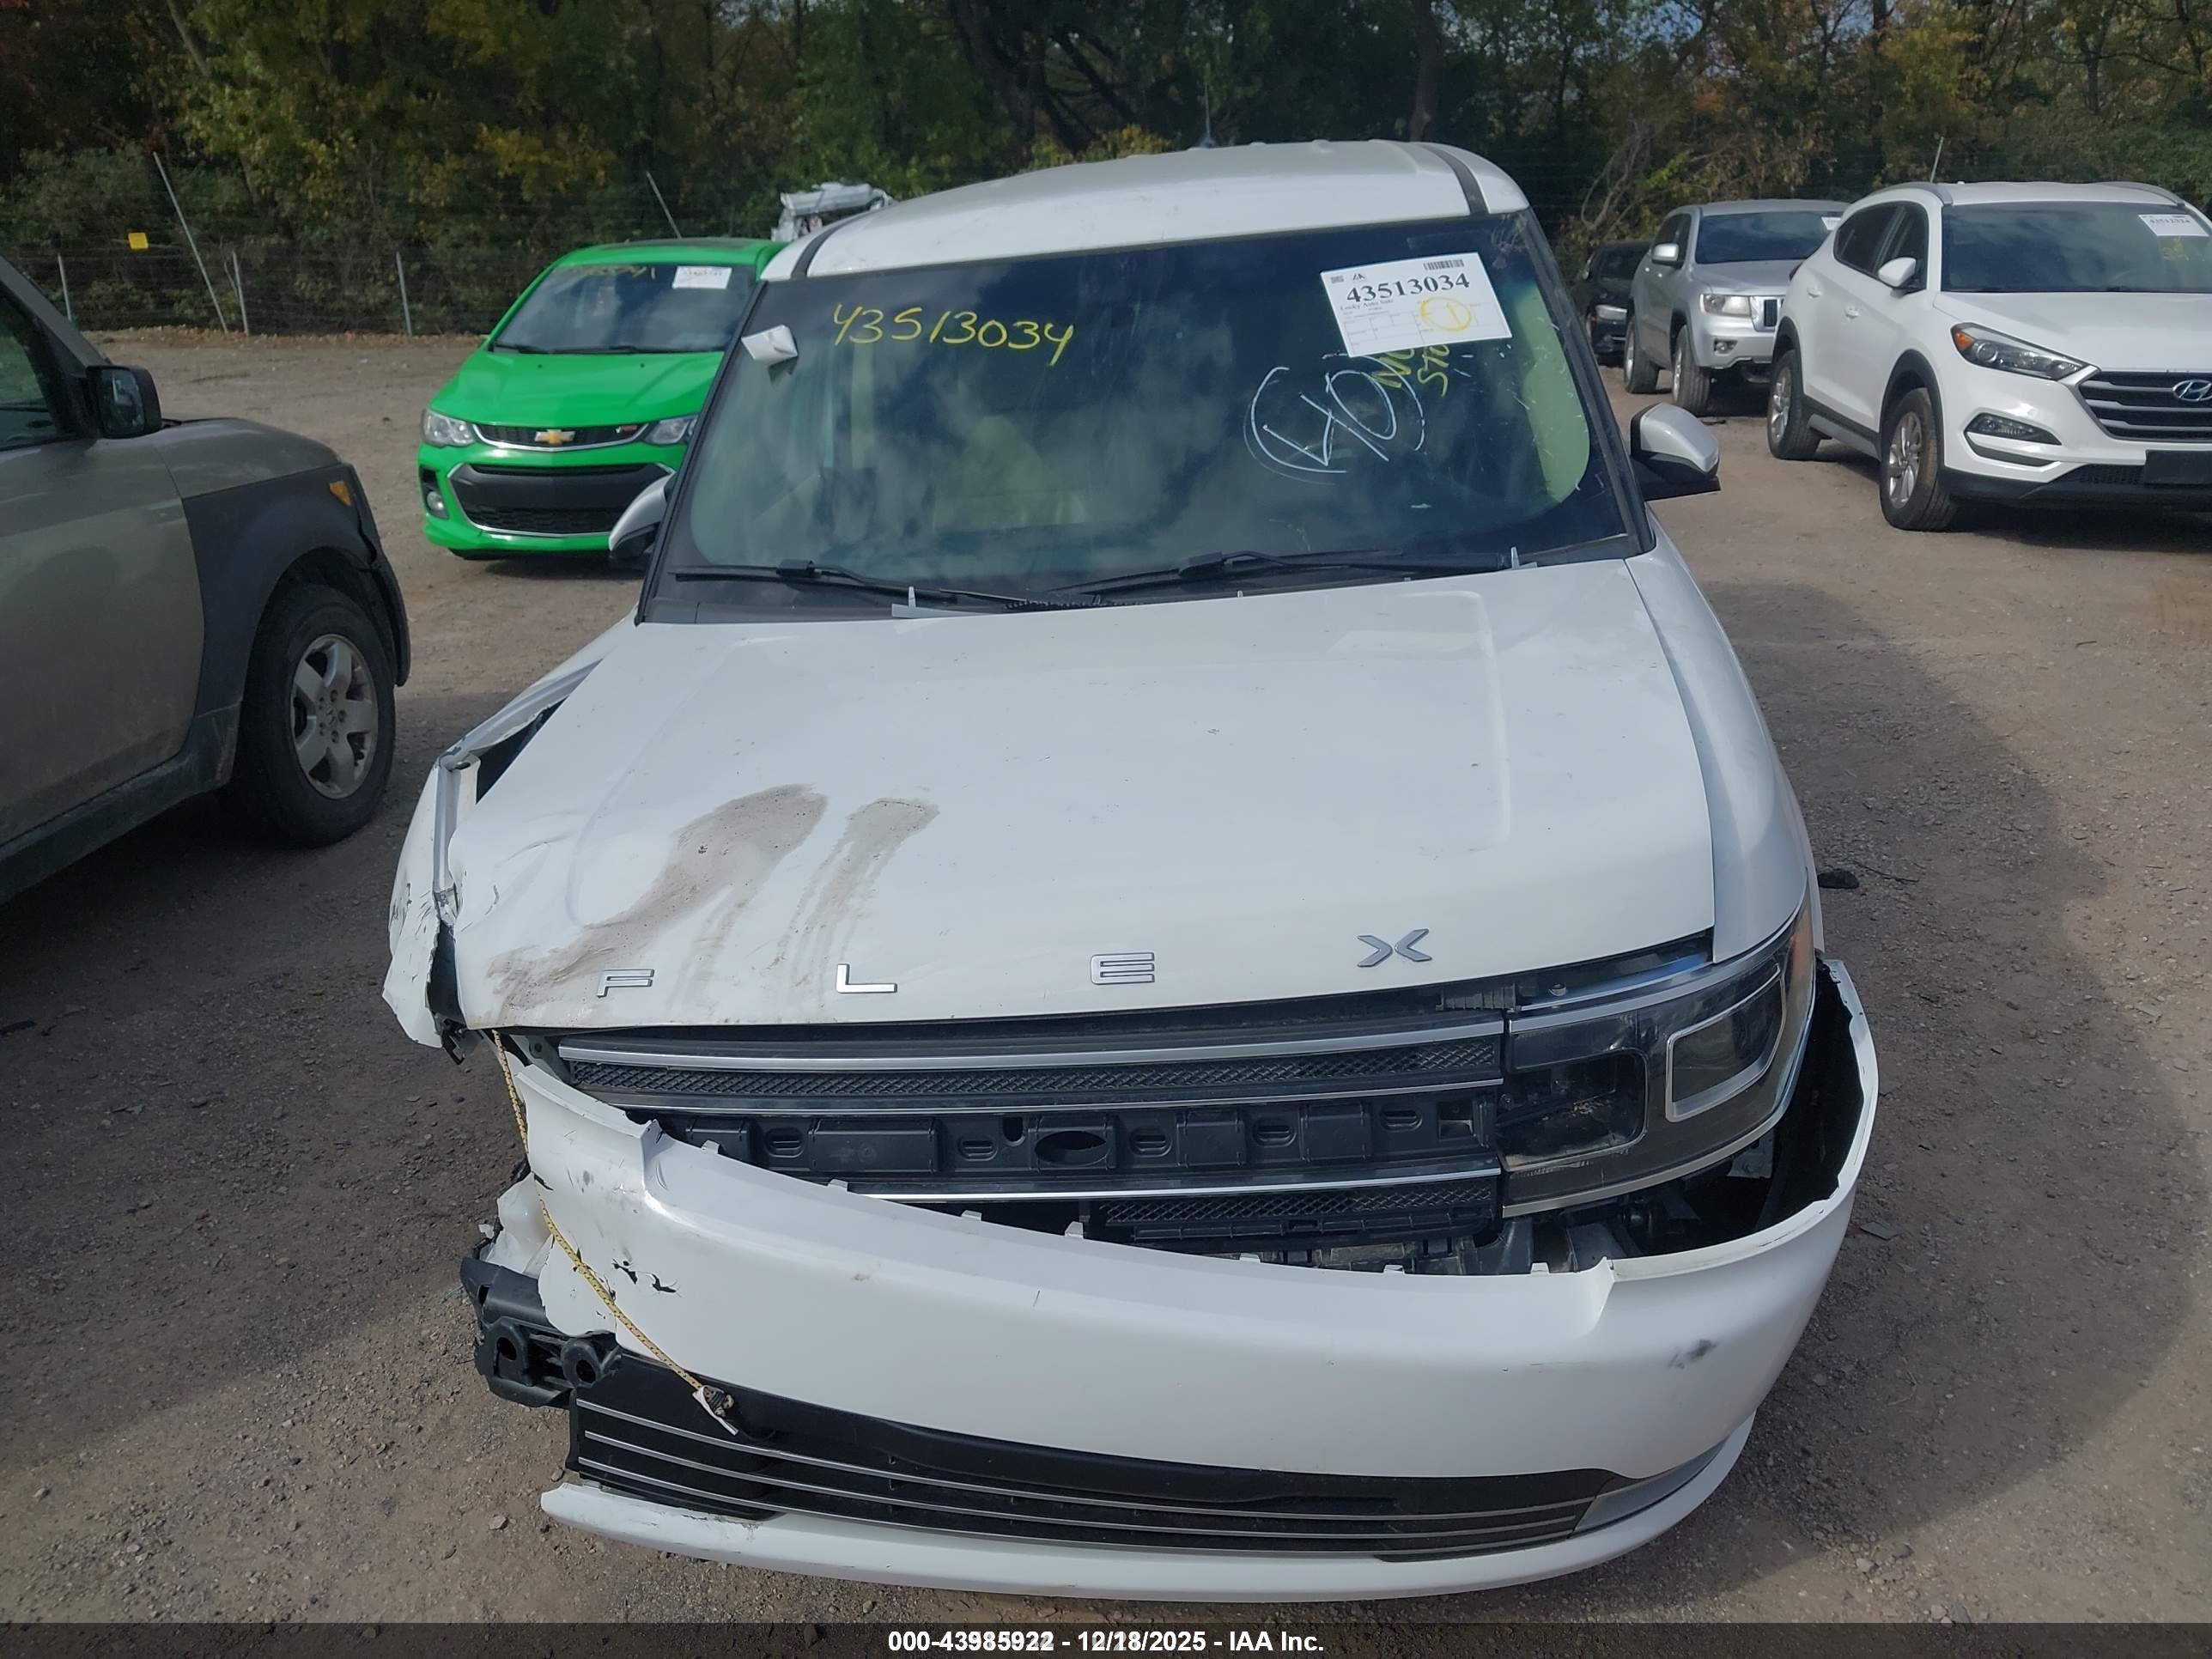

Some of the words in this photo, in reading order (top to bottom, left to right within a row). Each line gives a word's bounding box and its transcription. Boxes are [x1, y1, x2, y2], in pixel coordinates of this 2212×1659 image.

[1346, 272, 1470, 302] 43513034
[834, 304, 1074, 367] 43513034
[597, 927, 1433, 999] FLEX
